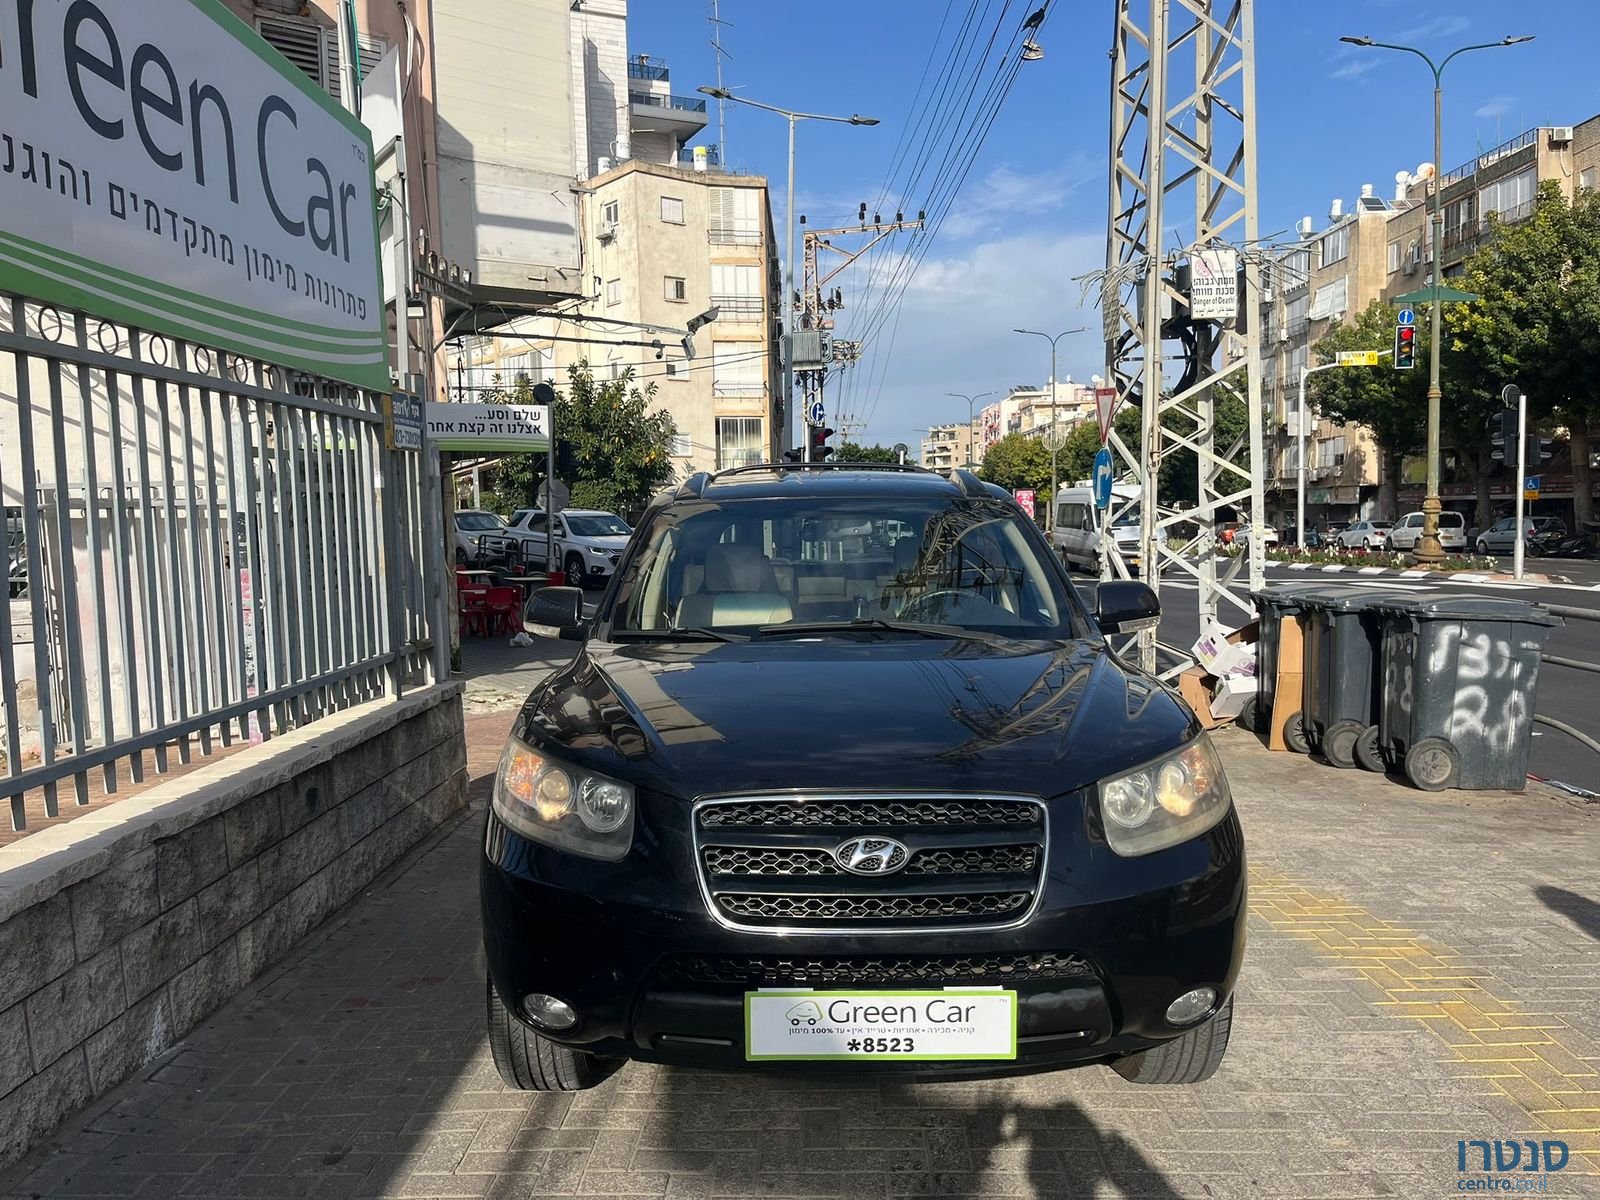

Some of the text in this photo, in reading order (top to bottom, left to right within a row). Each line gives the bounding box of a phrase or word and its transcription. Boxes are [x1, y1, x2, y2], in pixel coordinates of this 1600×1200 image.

[0, 0, 357, 263] reen Car
[108, 181, 235, 265] מתקדמים
[243, 244, 297, 292] מימון
[304, 272, 367, 321] פתרונות
[1216, 287, 1235, 296] סכנת
[1193, 296, 1235, 306] Danger of Death!
[474, 409, 541, 421] שלם וסע...
[428, 421, 454, 433] אחר
[458, 422, 485, 436] קצת
[489, 423, 503, 433] זה
[507, 422, 542, 434] אצלנו
[828, 999, 976, 1024] Green Car
[789, 1027, 809, 1036] מימון
[852, 1027, 863, 1035] אין
[957, 1027, 975, 1035] קניה
